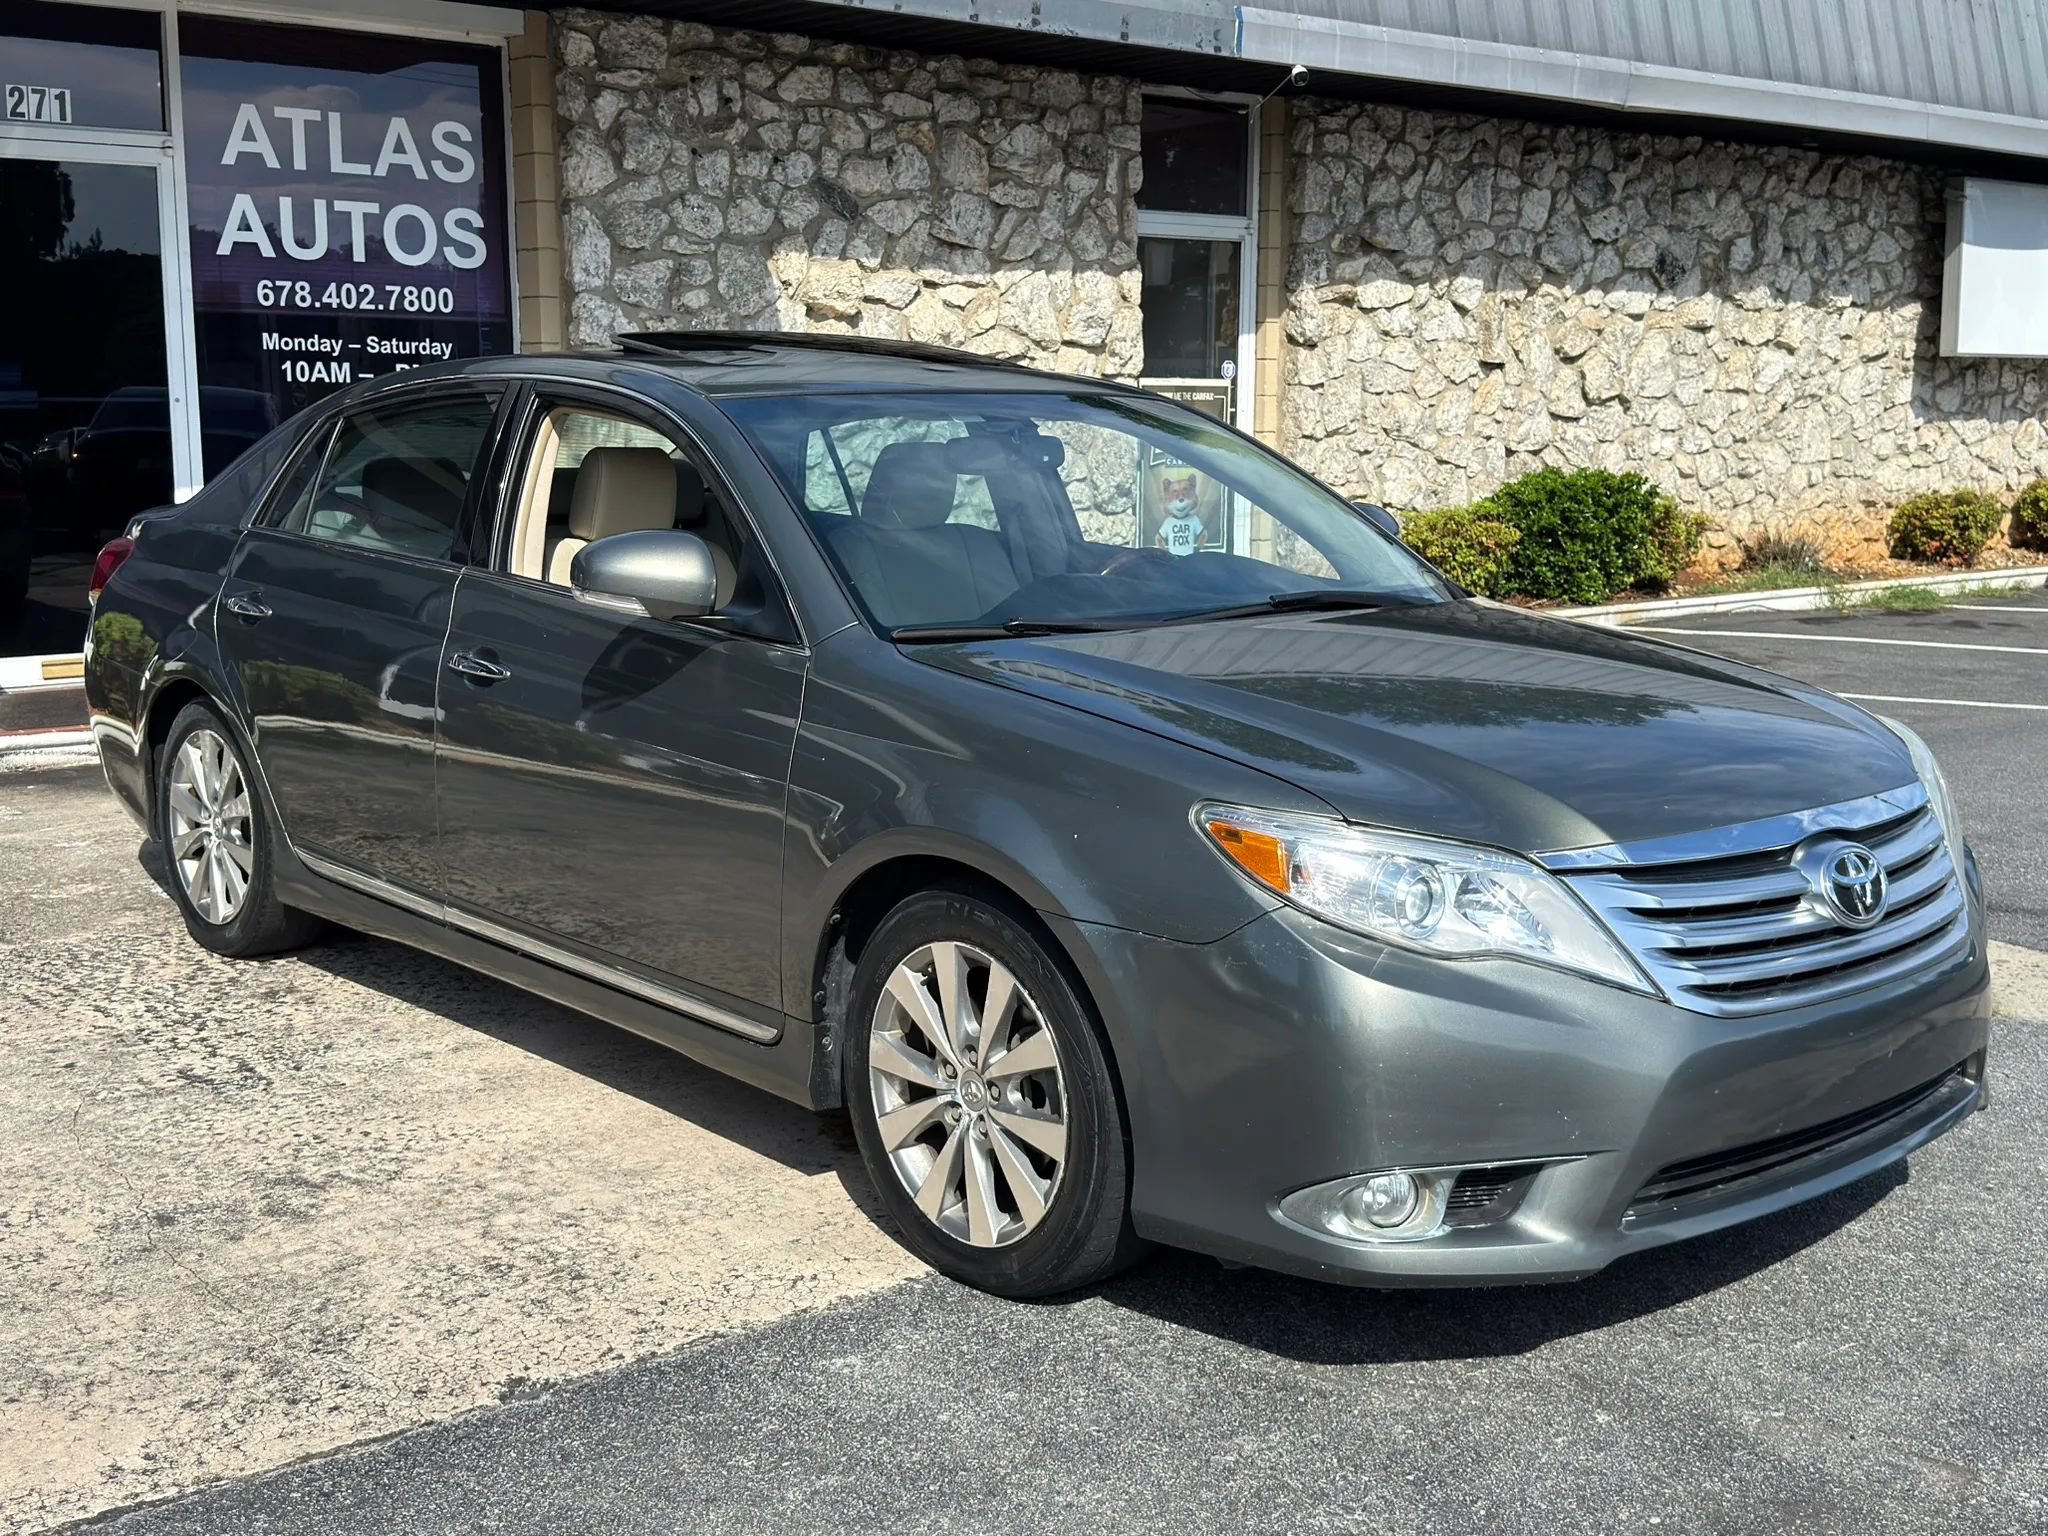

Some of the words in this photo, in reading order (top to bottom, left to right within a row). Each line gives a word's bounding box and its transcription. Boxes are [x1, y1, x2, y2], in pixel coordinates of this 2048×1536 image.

[8, 86, 67, 122] 271
[220, 103, 475, 183] ATLAS
[216, 193, 487, 269] AUTOS
[256, 279, 454, 313] 678.402.7800
[262, 332, 343, 356] Monday
[366, 336, 453, 359] Saturday
[281, 360, 351, 383] 10AM
[1192, 392, 1215, 401] CARFAX
[1172, 524, 1190, 535] CAR
[1173, 535, 1190, 546] FOX
